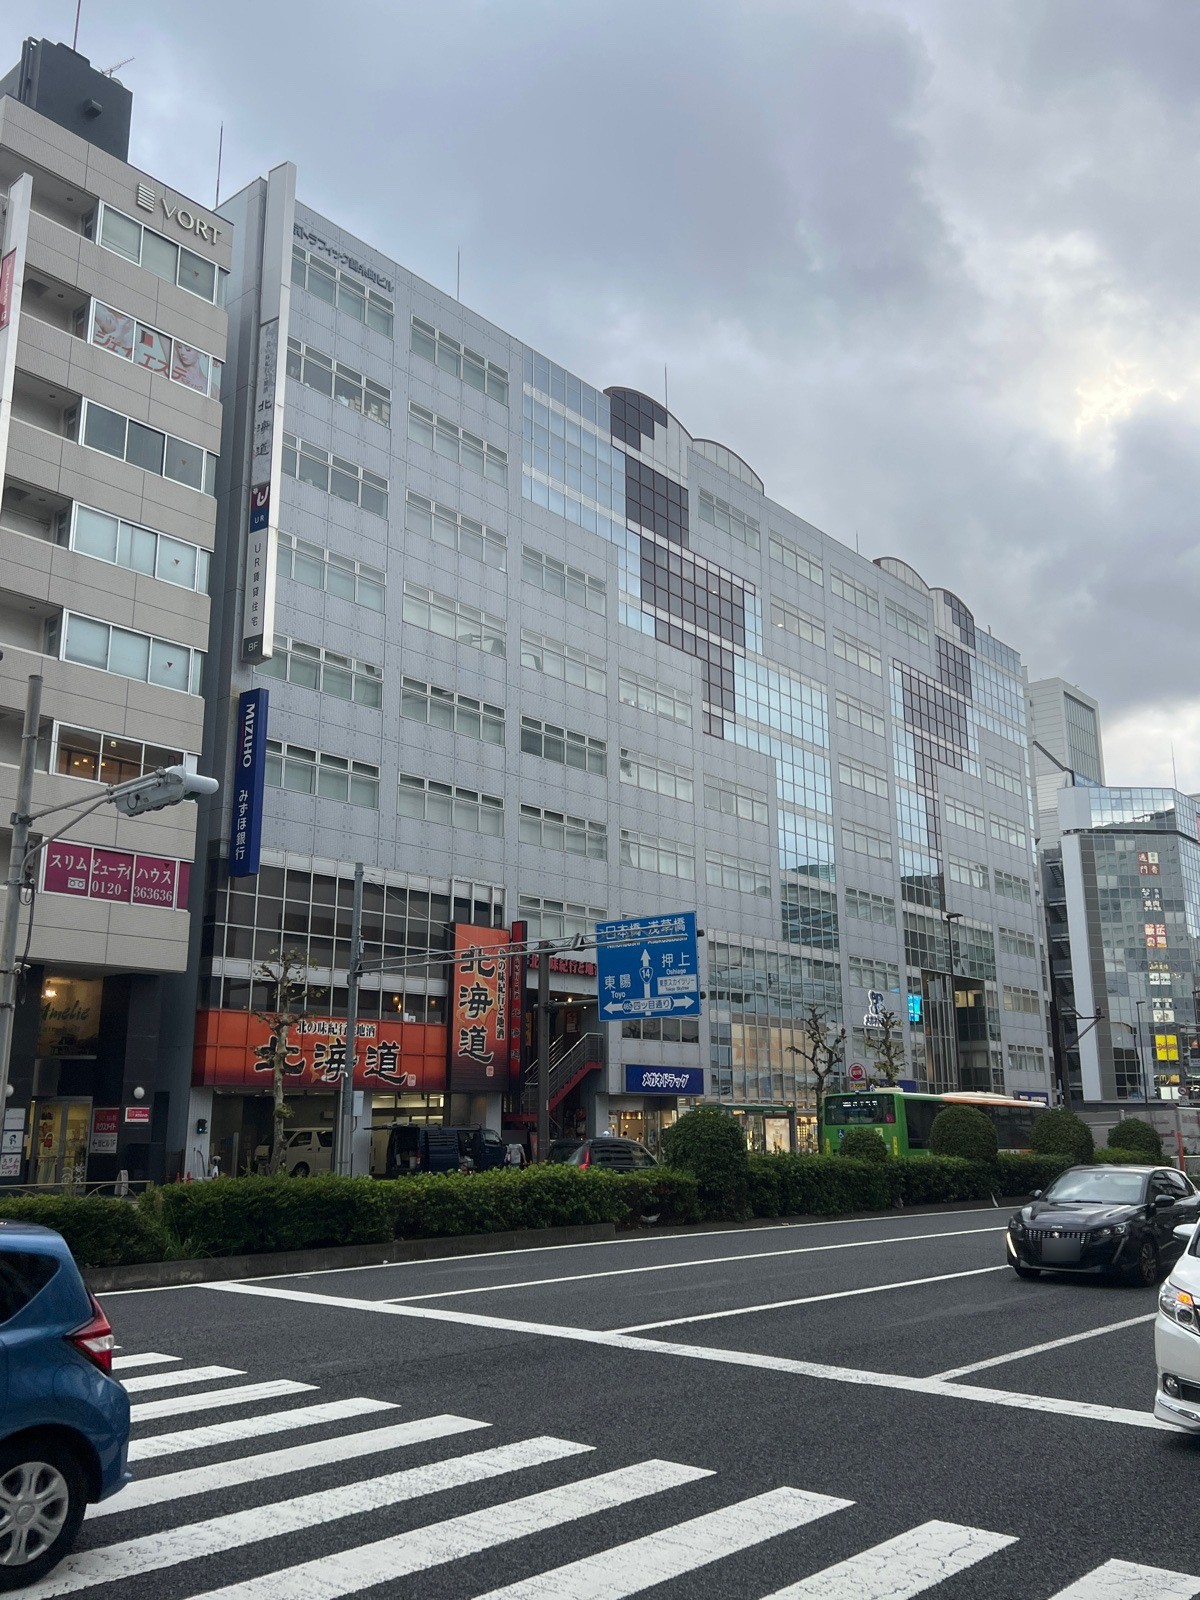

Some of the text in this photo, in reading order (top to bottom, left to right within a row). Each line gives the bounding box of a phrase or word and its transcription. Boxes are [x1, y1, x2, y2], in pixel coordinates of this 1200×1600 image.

[161, 198, 222, 245] VORT
[255, 400, 273, 457] 北海道
[254, 515, 265, 524] UR
[250, 543, 262, 627] UR賃貸住宅
[242, 702, 256, 769] MIZUHO
[235, 789, 249, 861] みずほ銀行
[605, 917, 686, 940] 日本橋 浅草橋
[662, 952, 691, 968] 押上
[641, 969, 650, 978] 14
[666, 968, 687, 976] Oshiage
[604, 973, 631, 990] 東陽
[659, 978, 695, 988] 東京スカイツリー
[611, 990, 626, 1000] Toyo
[458, 944, 496, 1064] 北海道
[633, 999, 670, 1010] 四ツ目通り
[296, 1020, 376, 1037] 北の味紀行地酒
[253, 1036, 408, 1086] 北海道
[642, 1072, 690, 1088] メガネドラッグ
